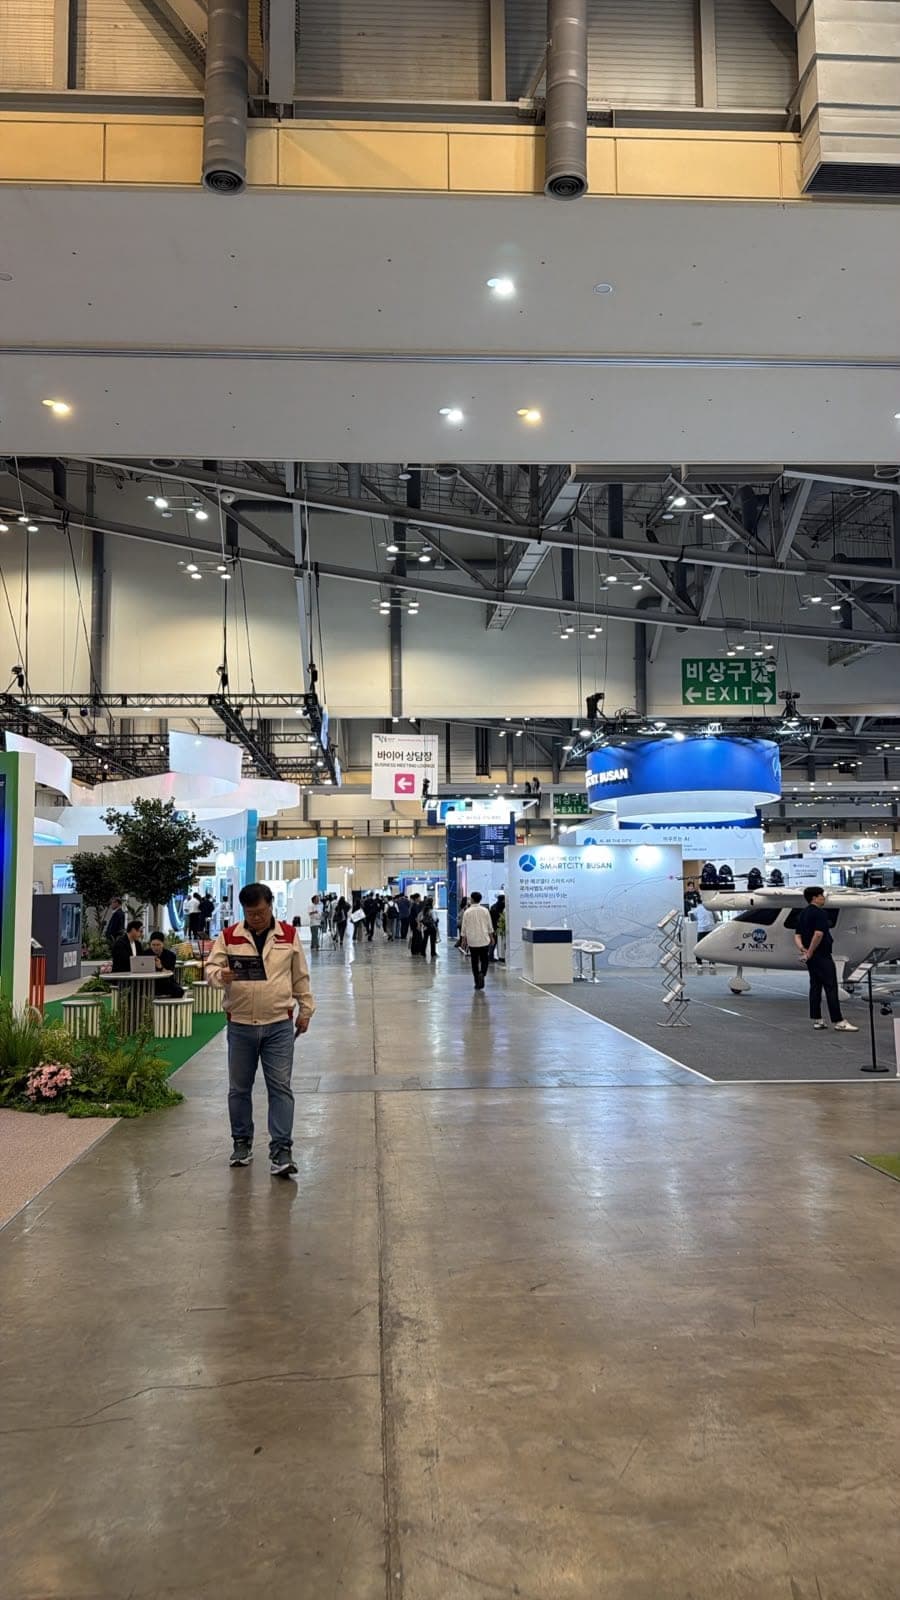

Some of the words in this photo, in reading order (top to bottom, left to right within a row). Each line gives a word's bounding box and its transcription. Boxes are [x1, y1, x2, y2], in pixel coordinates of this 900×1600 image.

[686, 662, 746, 682] 비상구
[705, 687, 752, 701] EXIT
[377, 750, 404, 761] 바이어
[406, 751, 432, 762] 상담장
[600, 767, 629, 784] BUSAN
[561, 806, 583, 814] EXIT
[540, 862, 584, 870] SMARTCITY
[586, 862, 613, 870] BUSAN
